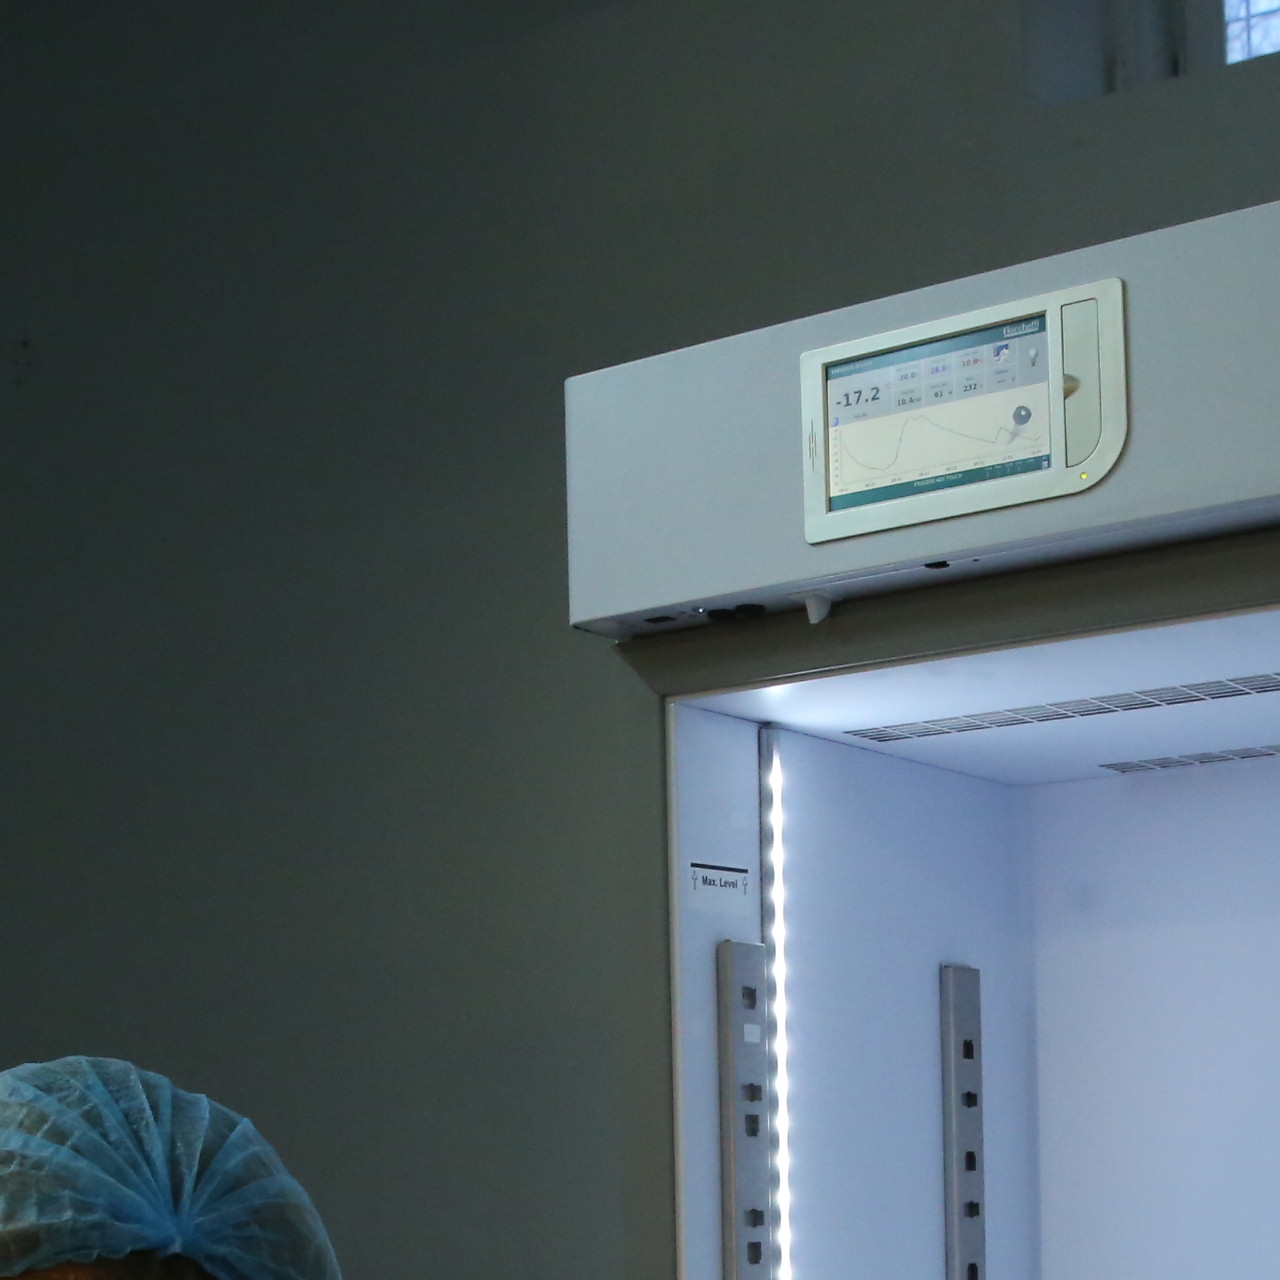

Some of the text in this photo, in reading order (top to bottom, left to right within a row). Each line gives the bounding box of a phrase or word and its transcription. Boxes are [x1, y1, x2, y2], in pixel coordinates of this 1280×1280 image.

[836, 386, 880, 408] -17.2
[701, 876, 738, 889] Max. Level
